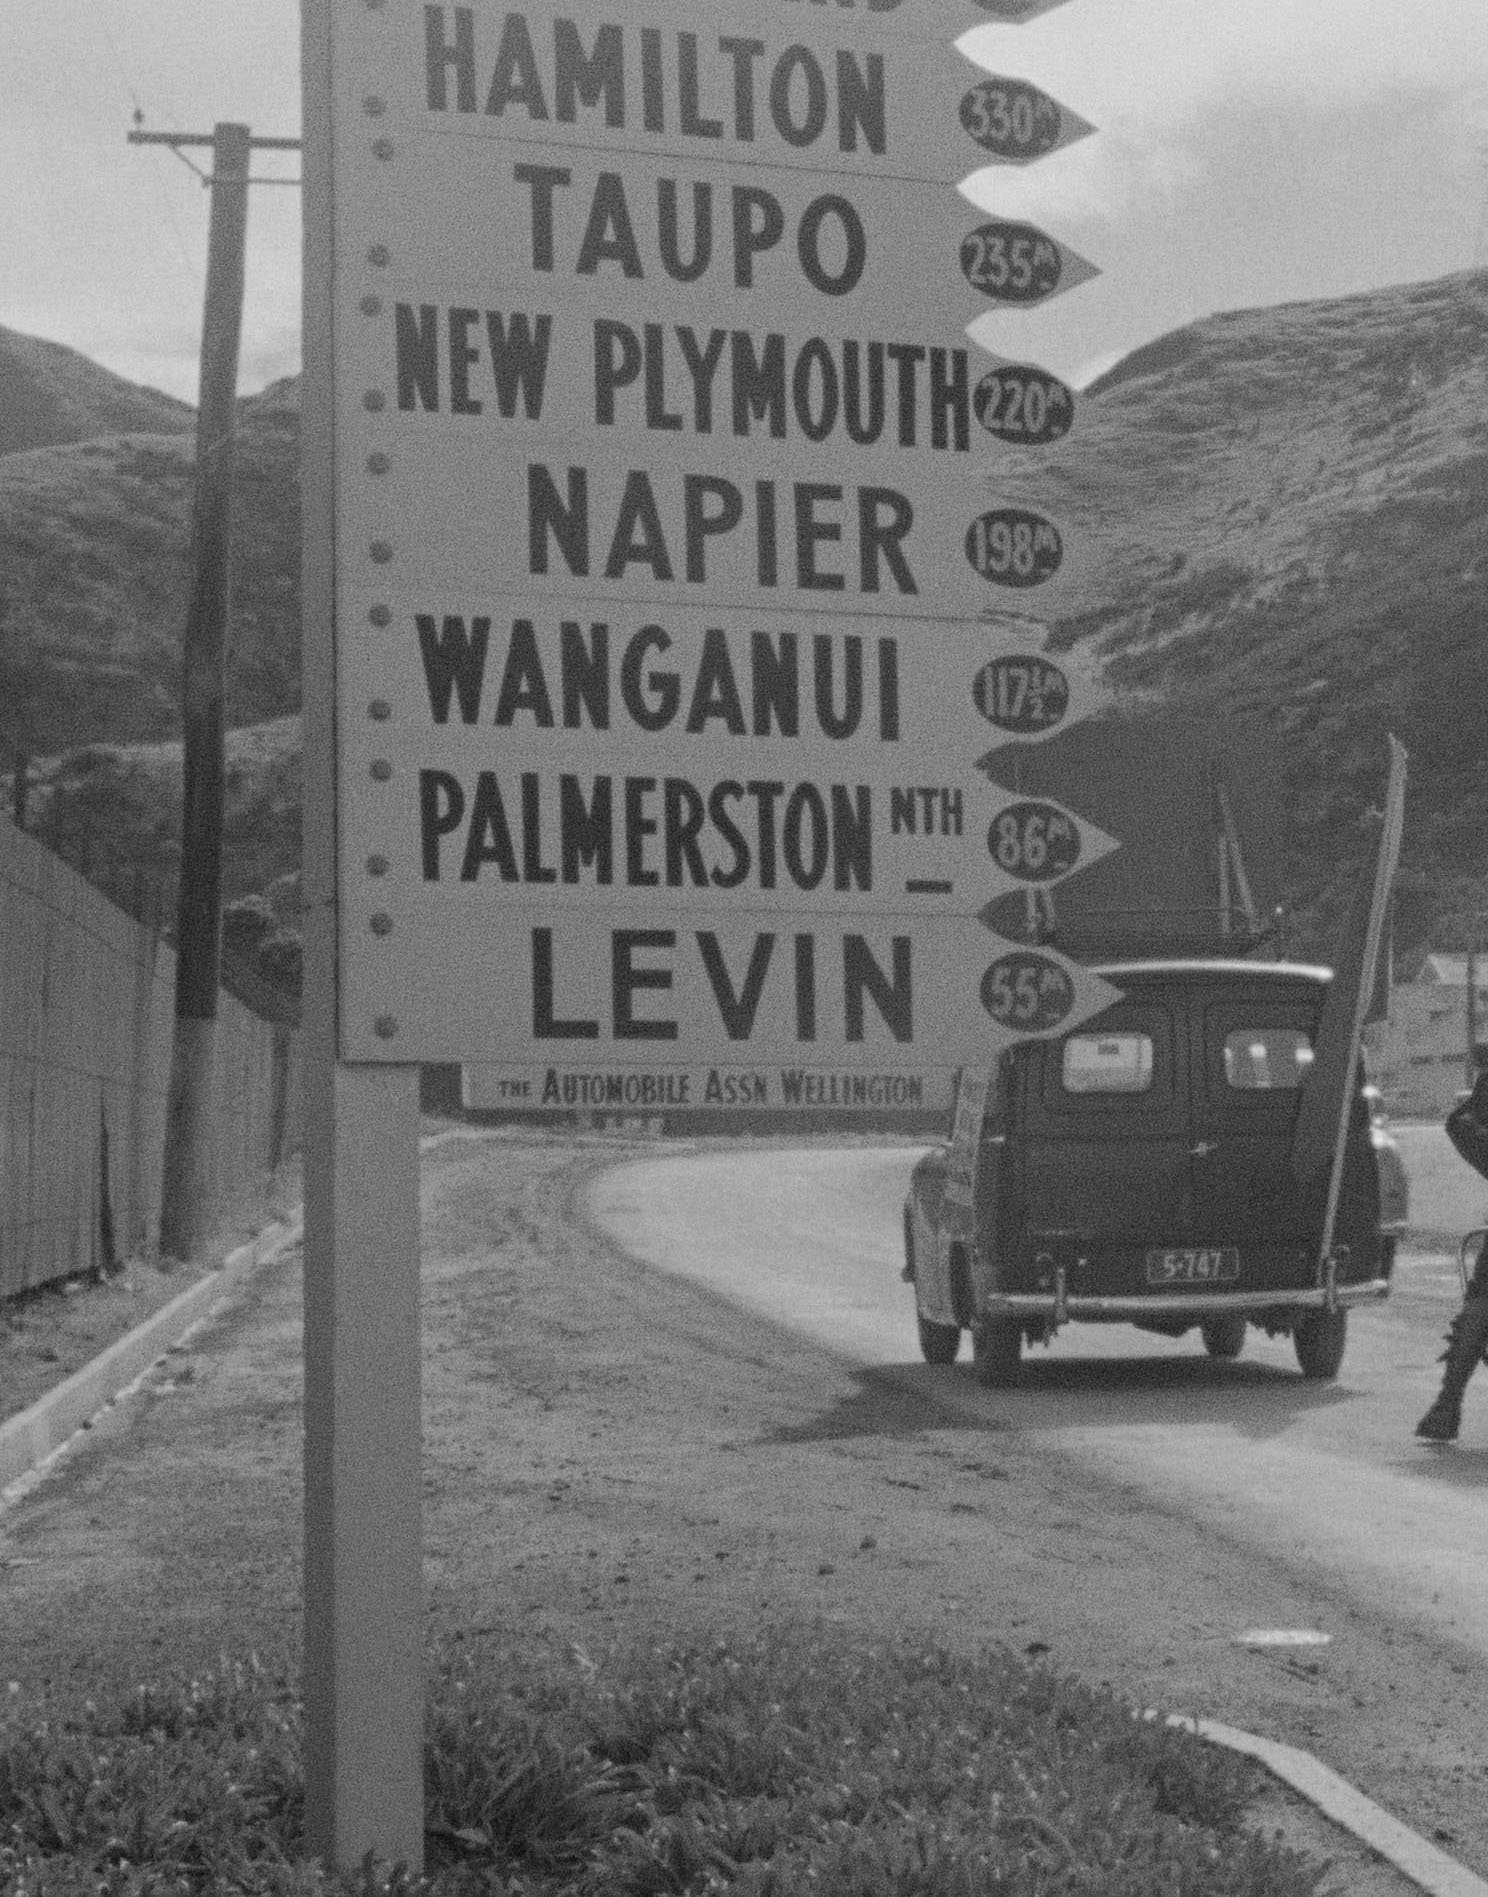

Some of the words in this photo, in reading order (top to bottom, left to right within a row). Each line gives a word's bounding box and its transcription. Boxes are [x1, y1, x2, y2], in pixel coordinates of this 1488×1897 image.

[422, 4, 887, 156] HAMILTON
[513, 163, 867, 297] TAUPO
[395, 302, 553, 421] NEW
[594, 318, 970, 453] PLYMOUTH
[527, 463, 919, 596] NAPIER
[414, 613, 900, 742] WANGANUI
[418, 768, 873, 893] PALMERSTON
[890, 786, 964, 836] NTH
[530, 926, 914, 1043] LEVIN
[499, 1079, 531, 1098] THE
[541, 1067, 691, 1104] AUTOMOBILE
[780, 1069, 923, 1105] WELLINGTON
